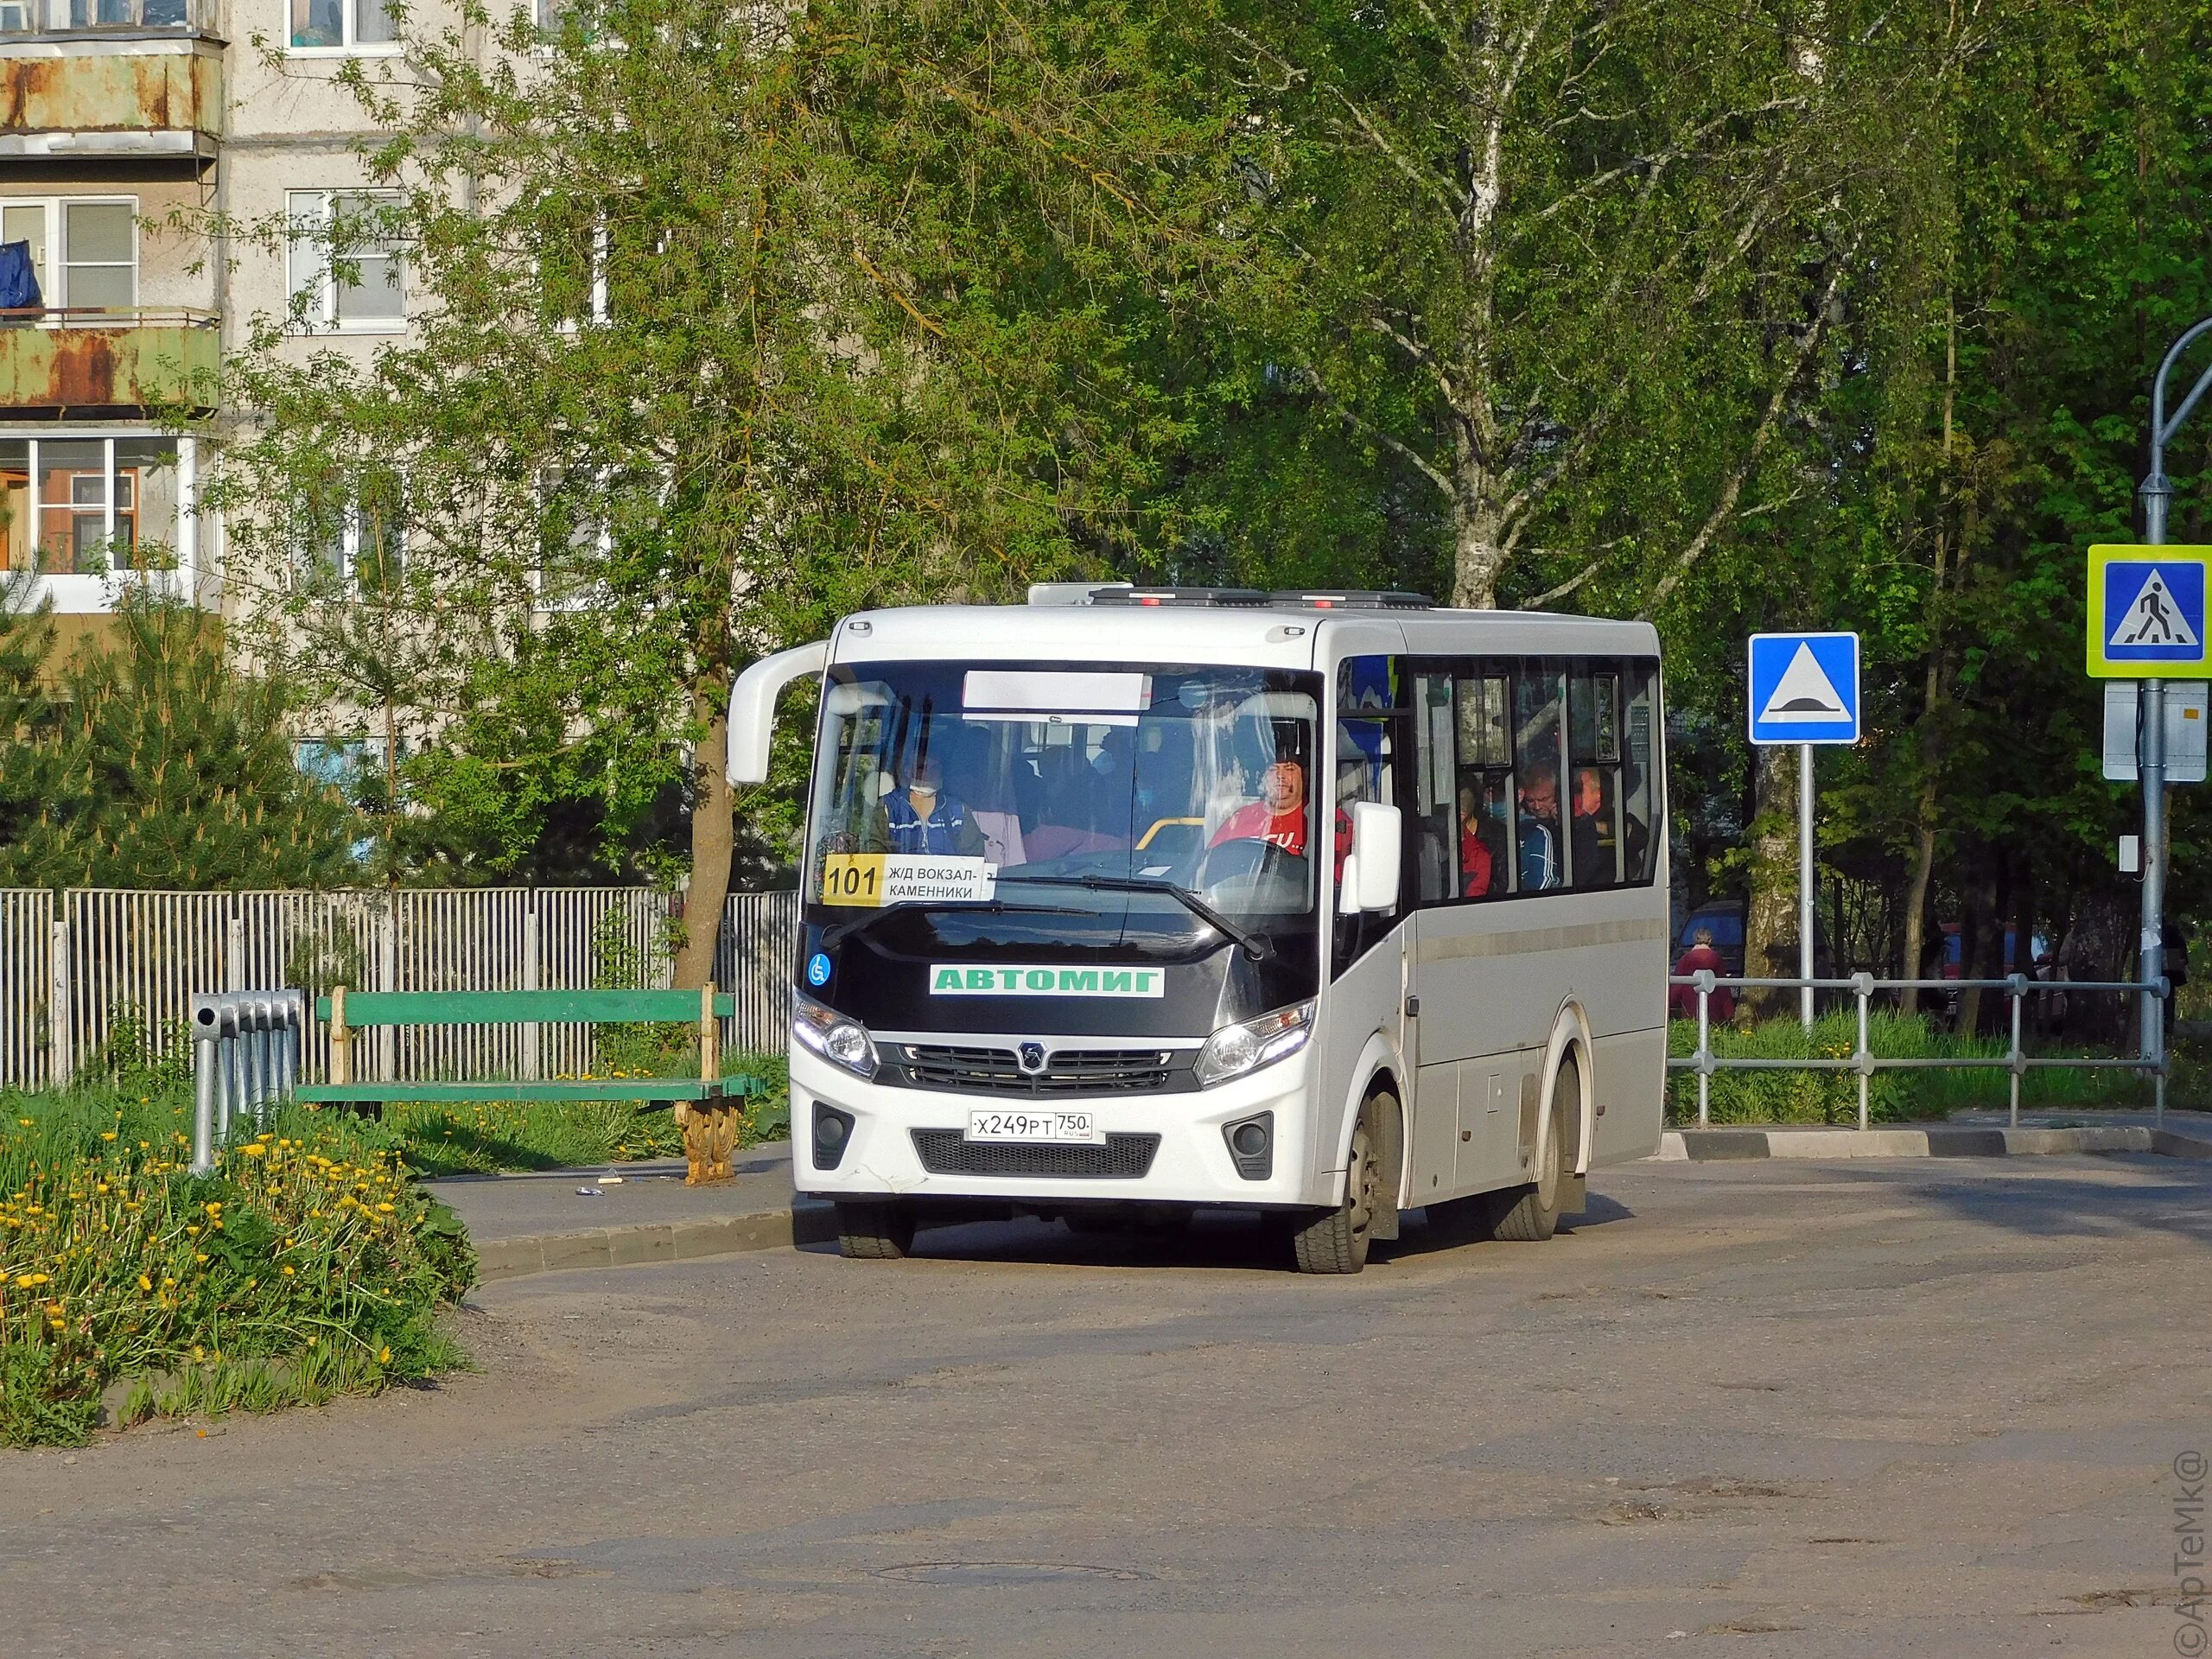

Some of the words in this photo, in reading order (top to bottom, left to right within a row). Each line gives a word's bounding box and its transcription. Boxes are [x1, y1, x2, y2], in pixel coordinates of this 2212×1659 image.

[828, 867, 876, 895] 101
[889, 867, 913, 880] Ж/Д
[917, 868, 977, 881] ВОКЗАЛ-
[889, 885, 973, 899] КАМЕННИКИ
[934, 969, 1159, 992] АВТОМИГ
[1057, 1115, 1086, 1130] 750
